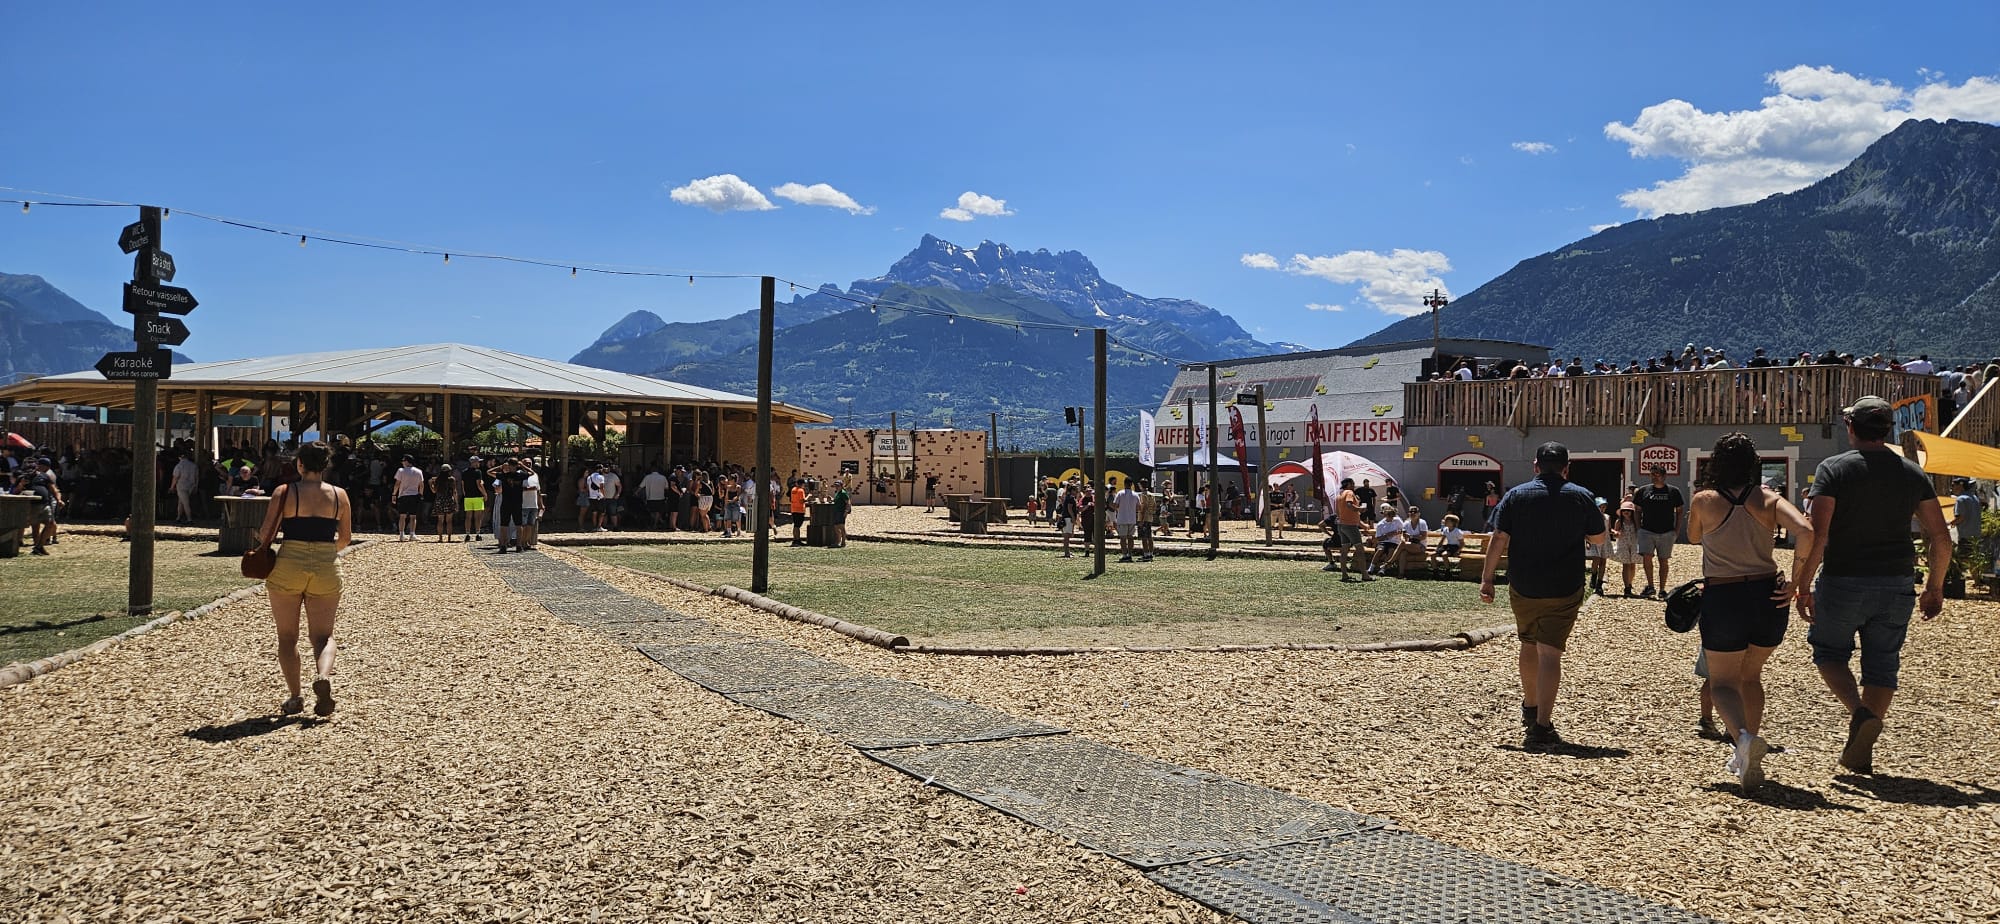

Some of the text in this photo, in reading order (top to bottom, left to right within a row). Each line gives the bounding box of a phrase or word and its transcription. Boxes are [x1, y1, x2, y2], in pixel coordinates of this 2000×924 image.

[132, 285, 189, 303] Retour vaisselles
[147, 321, 171, 335] Snack
[114, 357, 153, 368] Karaoké
[1249, 425, 1257, 441] à
[1267, 425, 1296, 445] ingot
[1305, 421, 1402, 443] RAIFFEISEN
[1643, 447, 1675, 460] ACCÈS
